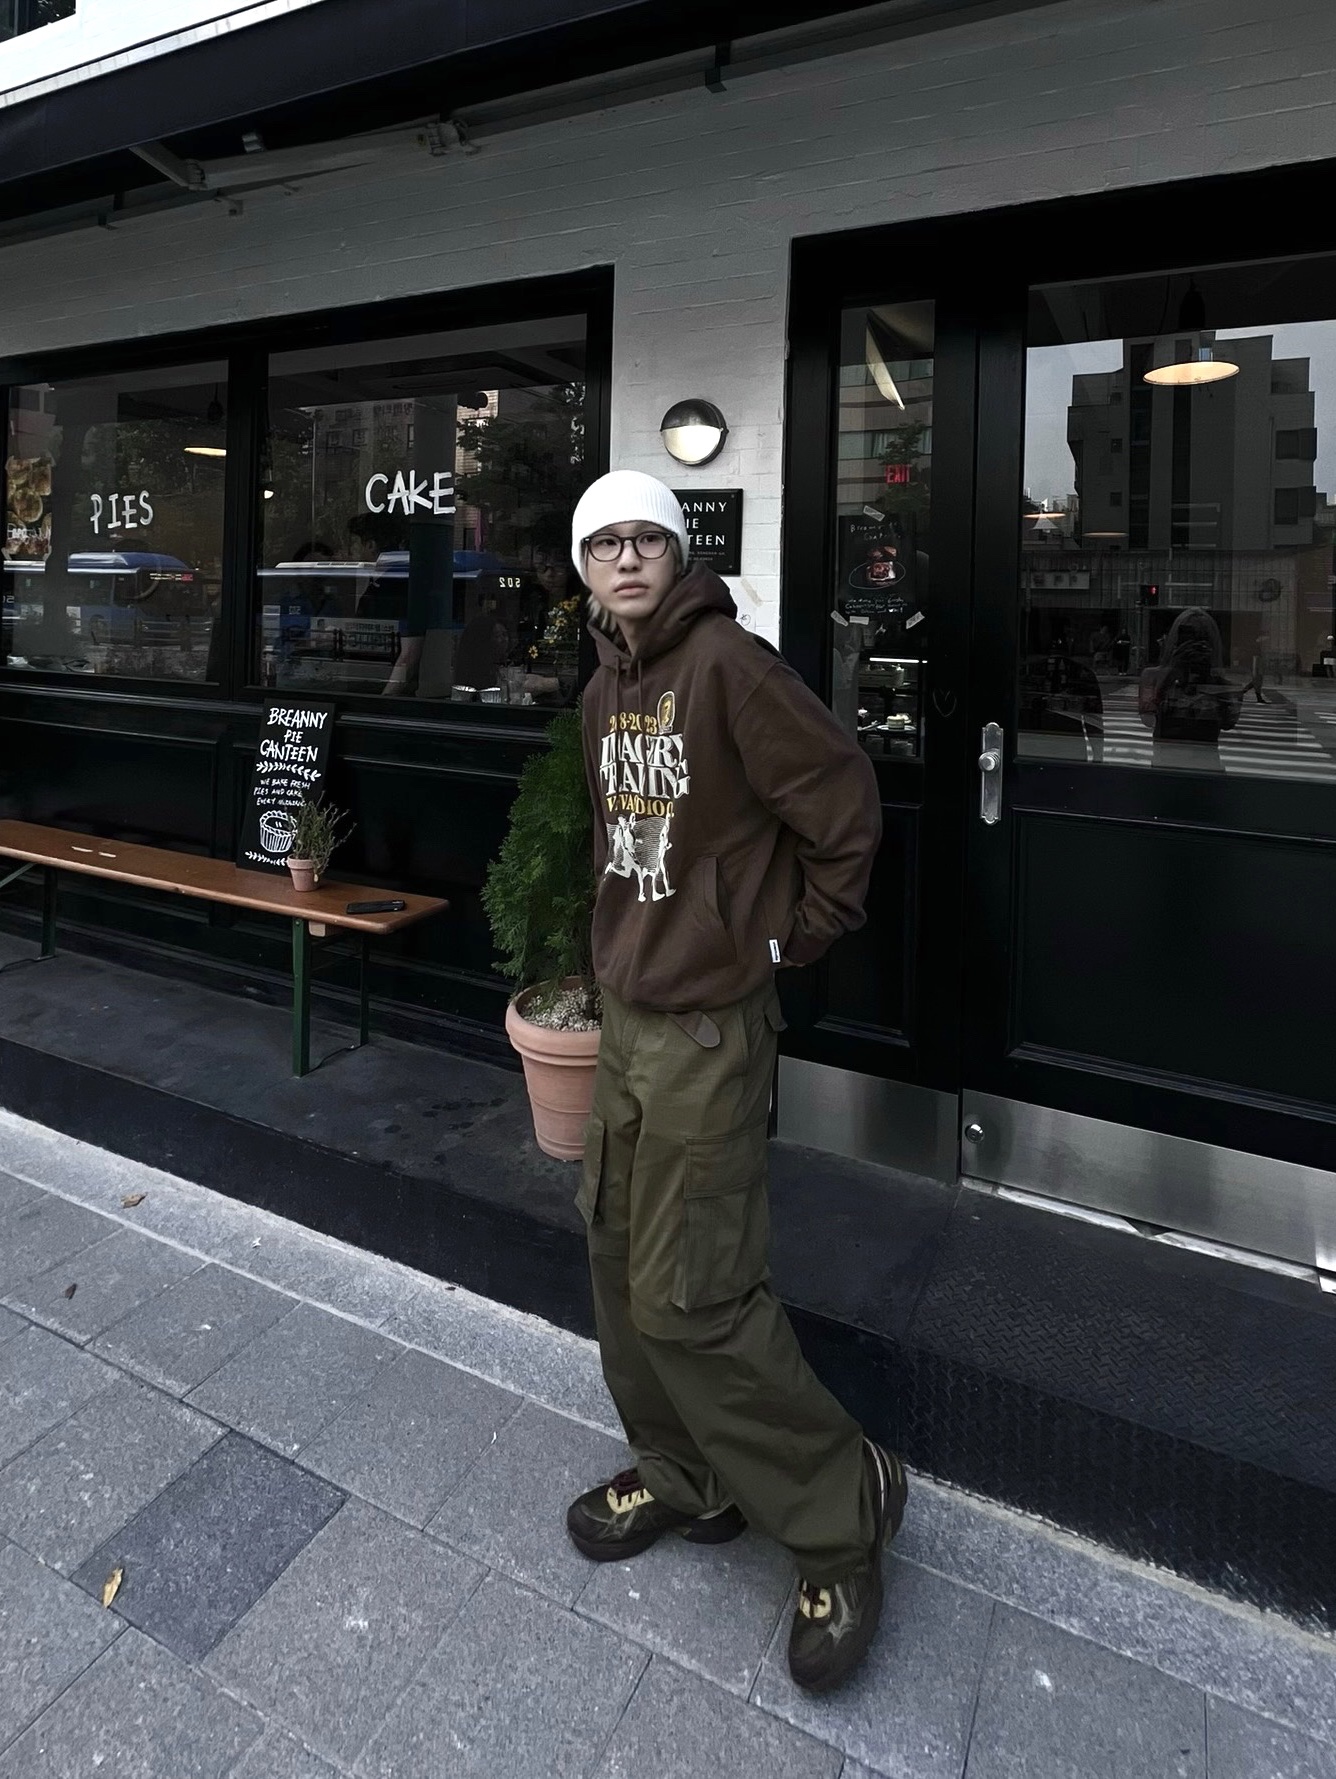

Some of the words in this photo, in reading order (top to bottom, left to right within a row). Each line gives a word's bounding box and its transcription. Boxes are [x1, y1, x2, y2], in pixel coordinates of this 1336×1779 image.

[884, 465, 910, 482] EXIT
[365, 469, 457, 516] CAKE
[90, 490, 154, 534] PIES
[681, 501, 727, 512] ANNY
[686, 518, 699, 529] IE
[687, 534, 725, 546] TEEN
[267, 707, 328, 729] BREANNY
[284, 729, 304, 743] PIE
[260, 739, 318, 762] CANTEEN
[260, 777, 271, 786] WE
[271, 778, 289, 787] BAKE
[290, 779, 311, 790] FRESH
[253, 786, 269, 796] PIES
[286, 789, 303, 798] CAKE
[256, 797, 277, 806] EVERY
